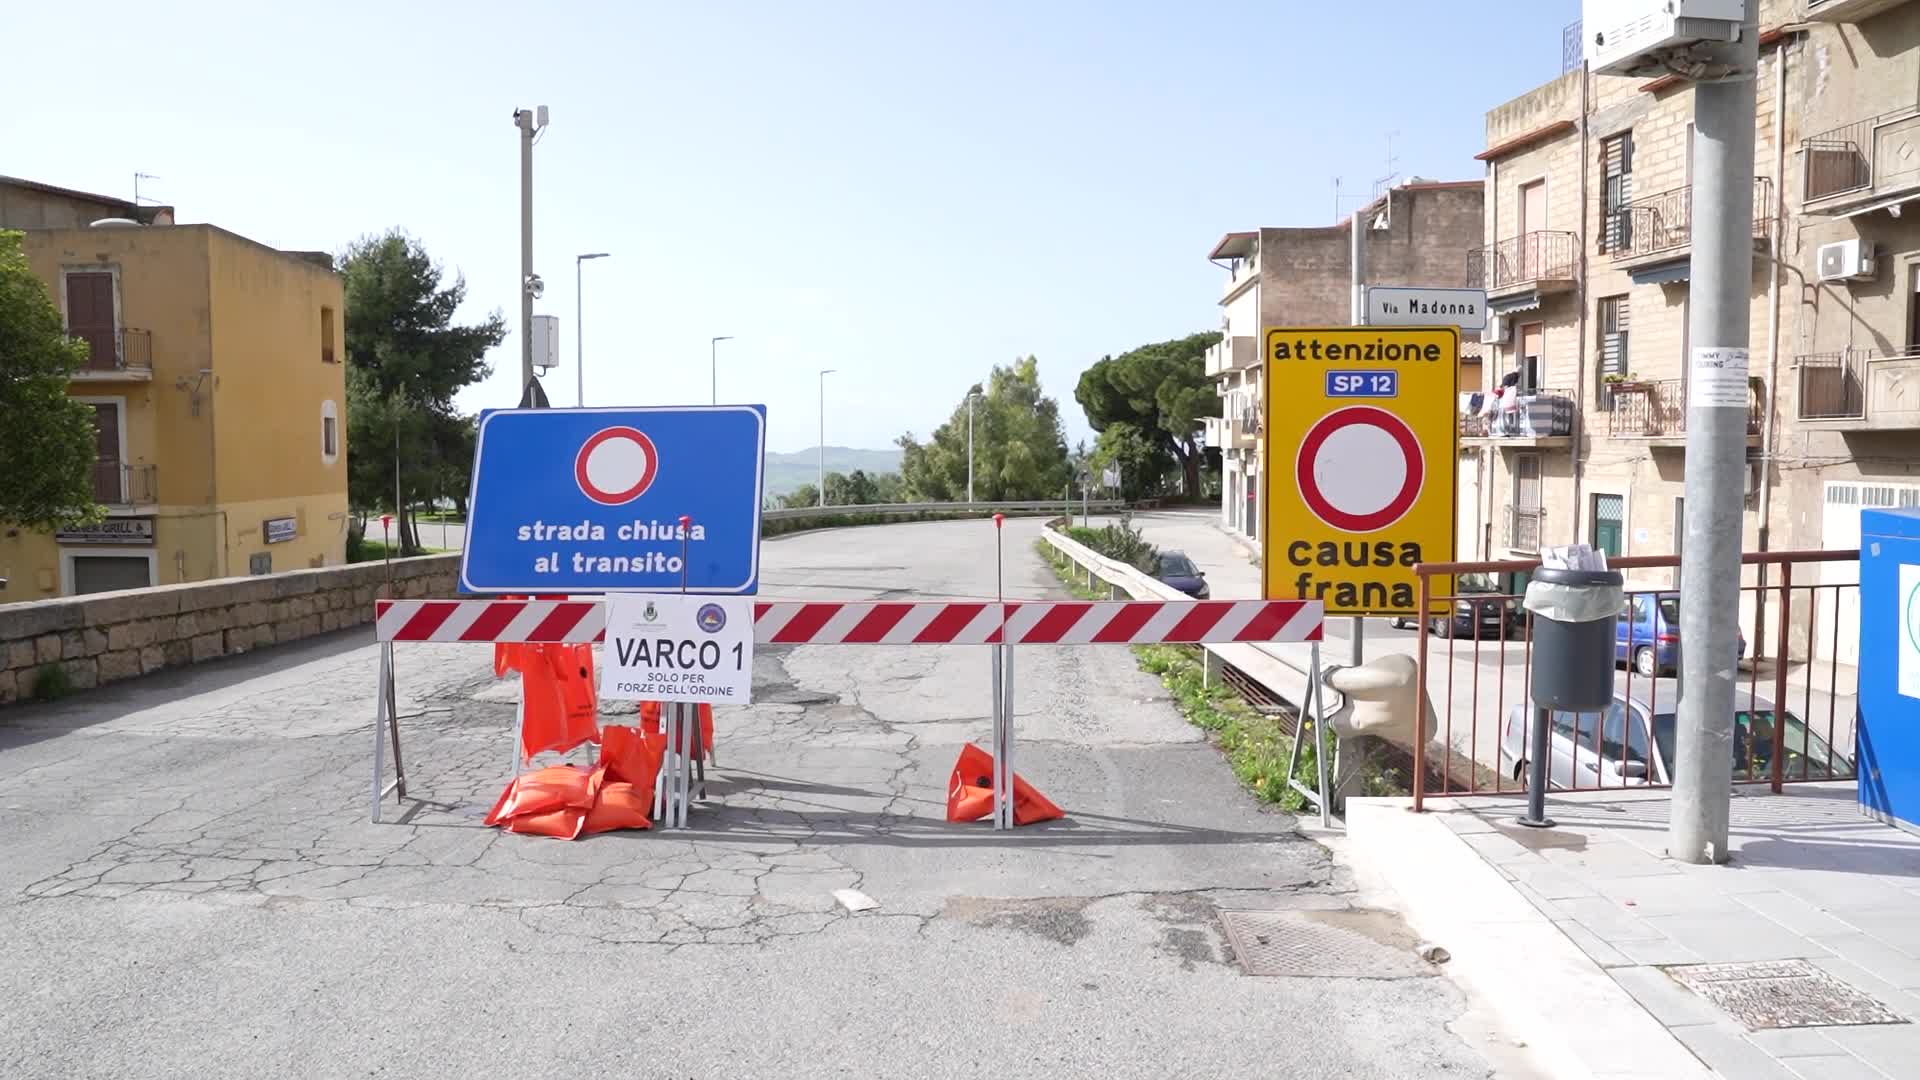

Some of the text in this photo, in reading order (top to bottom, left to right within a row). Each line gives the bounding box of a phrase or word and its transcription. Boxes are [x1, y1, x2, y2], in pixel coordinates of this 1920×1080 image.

[1382, 299, 1475, 315] Via Madonna
[1274, 338, 1441, 361] attenzione
[1333, 375, 1391, 392] SP 12
[102, 520, 133, 534] GRILL
[517, 515, 705, 541] strada chiusa
[534, 551, 683, 574] al transito
[1287, 540, 1423, 567] causa
[1294, 572, 1415, 608] frana
[615, 637, 743, 671] VARCO 1
[616, 682, 735, 697] FORZE DELL'ORDINE
[647, 672, 705, 684] SOLO PER
